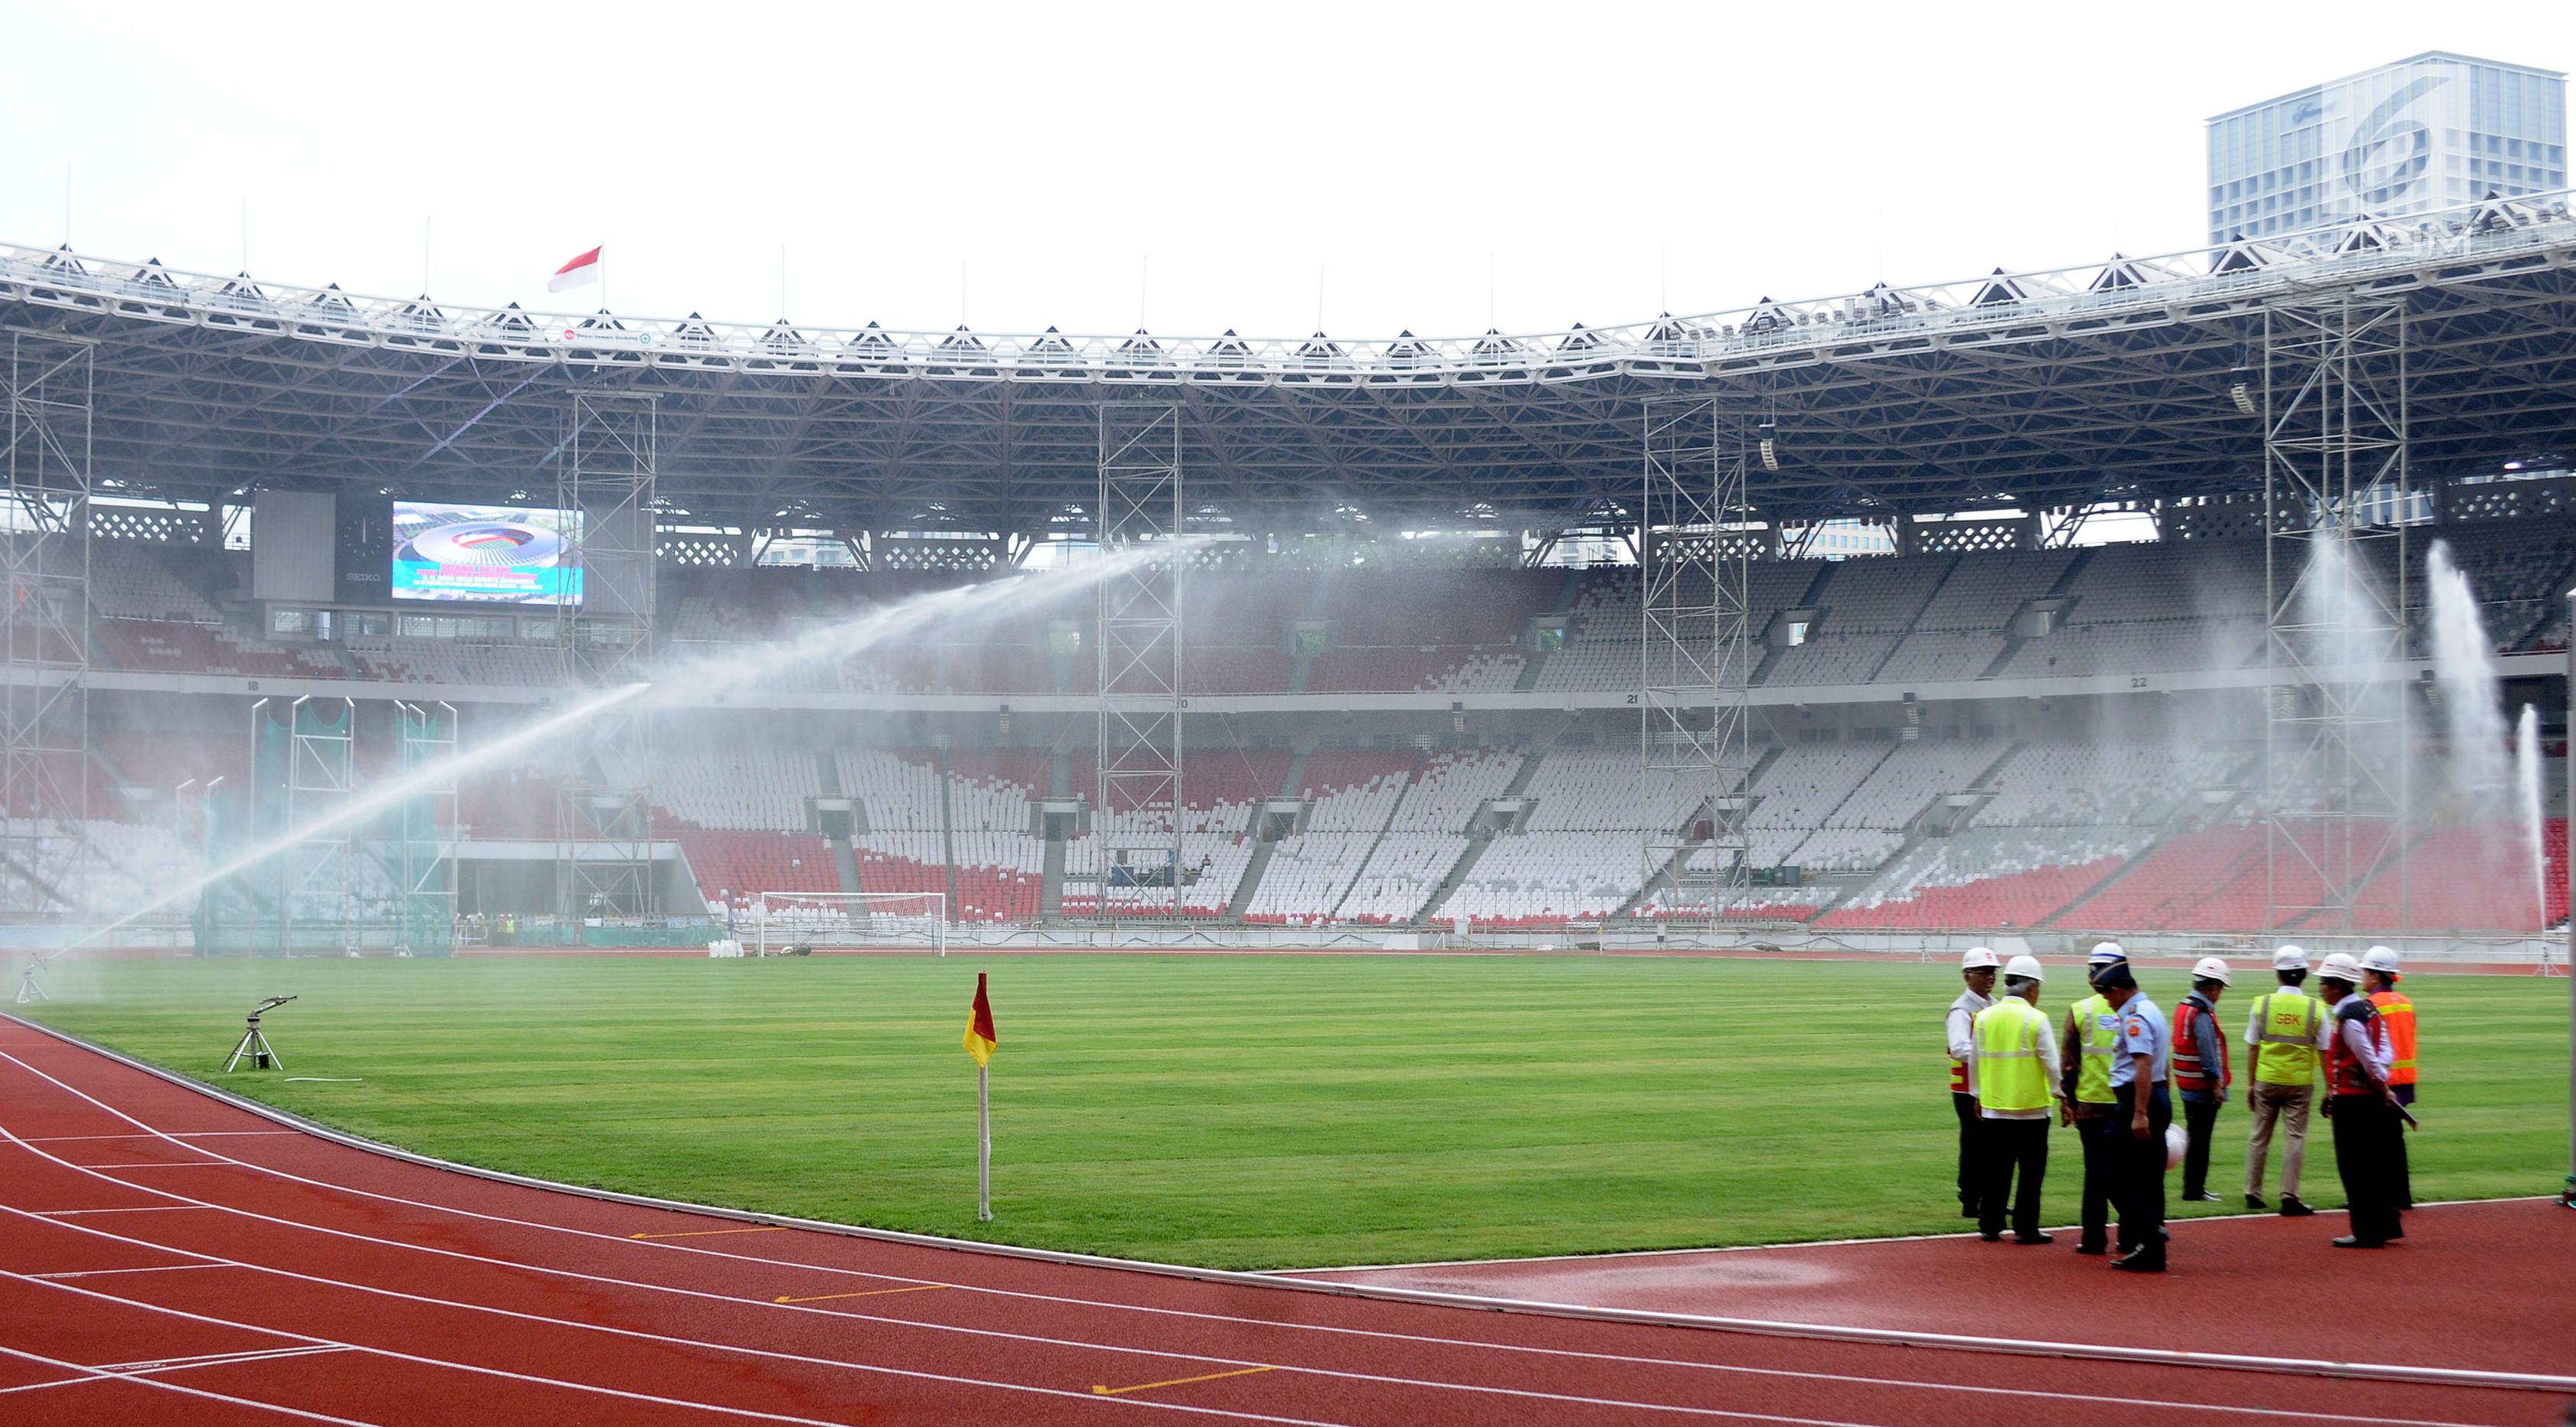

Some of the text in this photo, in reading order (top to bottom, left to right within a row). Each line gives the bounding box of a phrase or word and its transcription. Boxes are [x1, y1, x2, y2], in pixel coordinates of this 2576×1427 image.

[346, 573, 381, 583] SEIKO
[247, 681, 259, 691] 18
[2131, 677, 2148, 687] 22
[1626, 694, 1638, 704] 21
[2275, 1013, 2301, 1026] GBK
